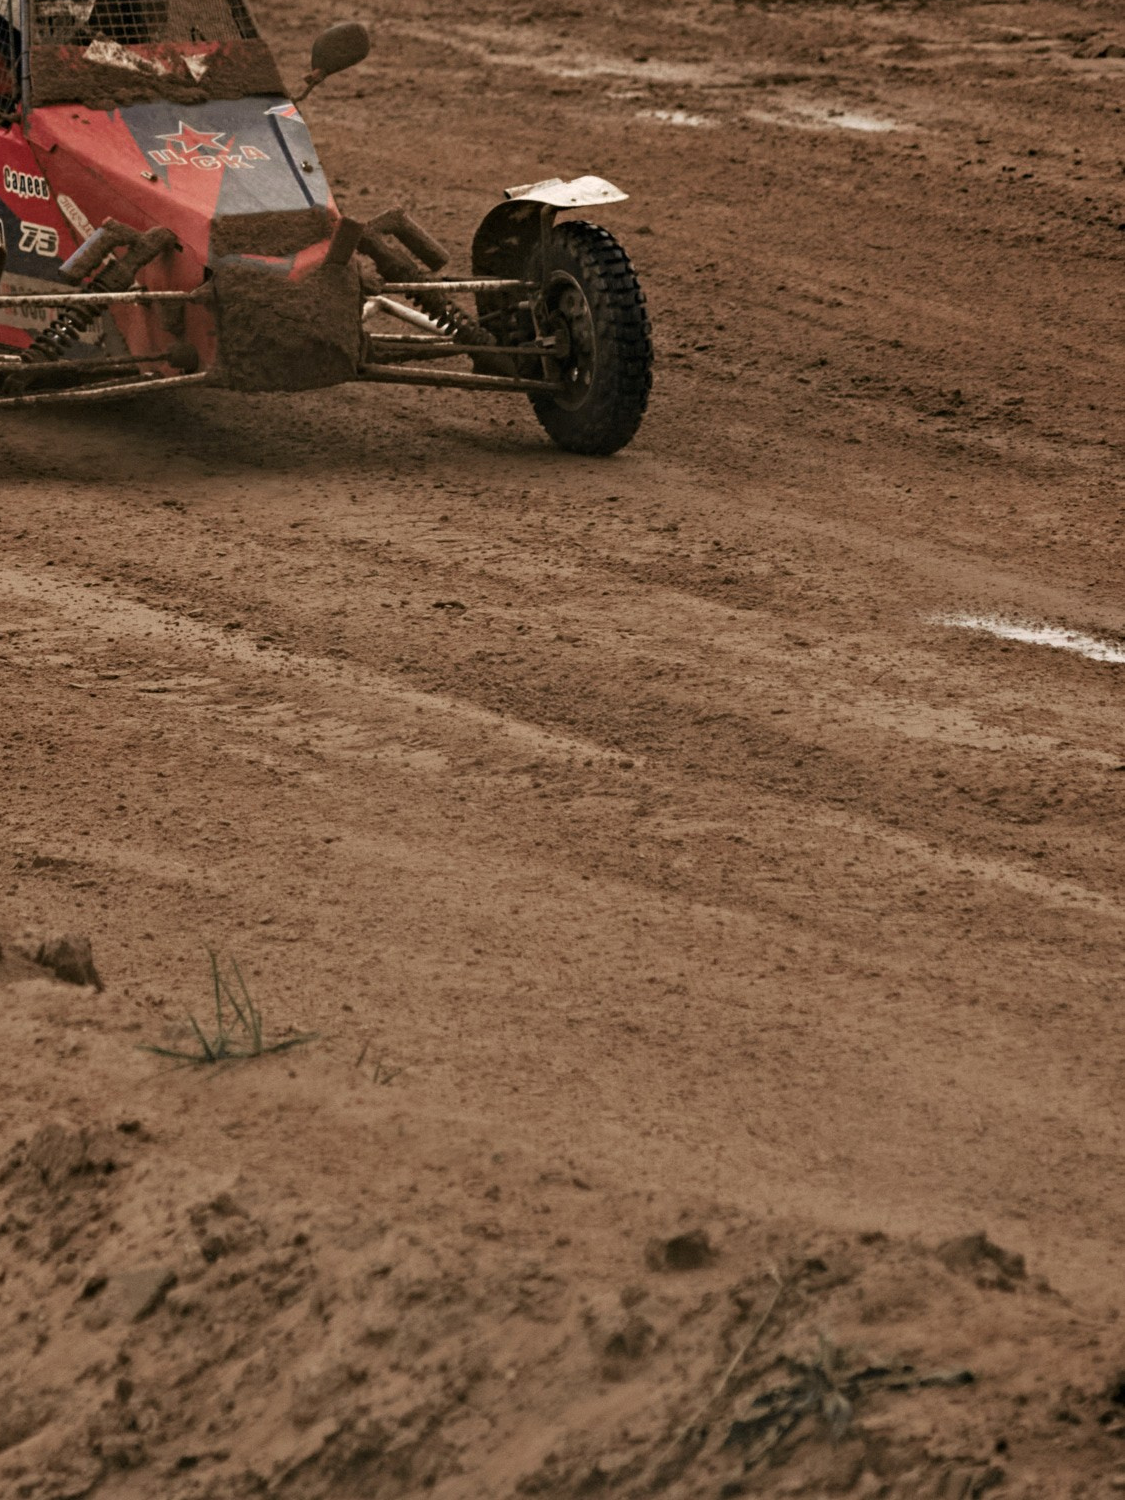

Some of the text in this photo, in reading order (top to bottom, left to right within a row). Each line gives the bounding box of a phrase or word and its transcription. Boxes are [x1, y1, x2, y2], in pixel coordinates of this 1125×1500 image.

[147, 145, 271, 170] ЦСКА
[2, 164, 49, 200] Садеев
[18, 220, 59, 258] 73
